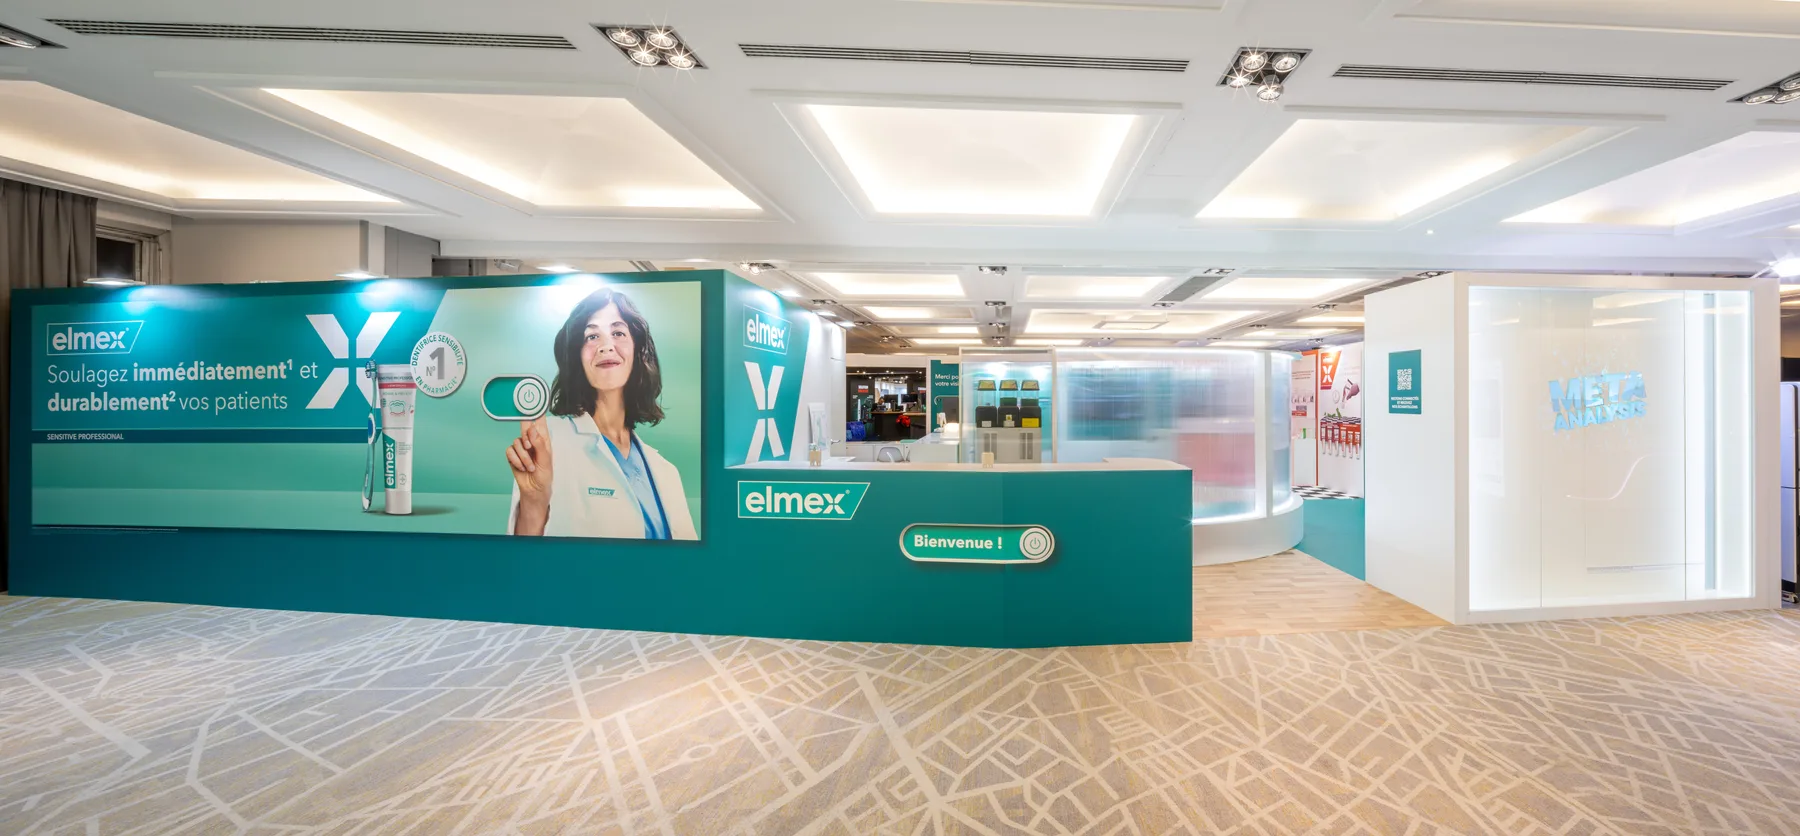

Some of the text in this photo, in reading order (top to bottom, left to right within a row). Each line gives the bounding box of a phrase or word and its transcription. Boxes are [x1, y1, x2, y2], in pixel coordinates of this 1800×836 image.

[52, 326, 126, 351] elmex
[746, 313, 785, 350] elmex
[411, 334, 437, 366] DENTIFRICE
[47, 363, 128, 387] Soulagez
[300, 362, 318, 379] et
[415, 375, 424, 386] EN
[179, 396, 209, 410] vos
[215, 391, 288, 415] patients
[1548, 370, 1647, 413] META
[1554, 400, 1647, 432] ANALYSIS
[47, 433, 77, 441] SENSITIVE
[385, 443, 394, 486] elmex
[745, 486, 846, 514] elmex
[914, 534, 1002, 550] Bienvenue !
